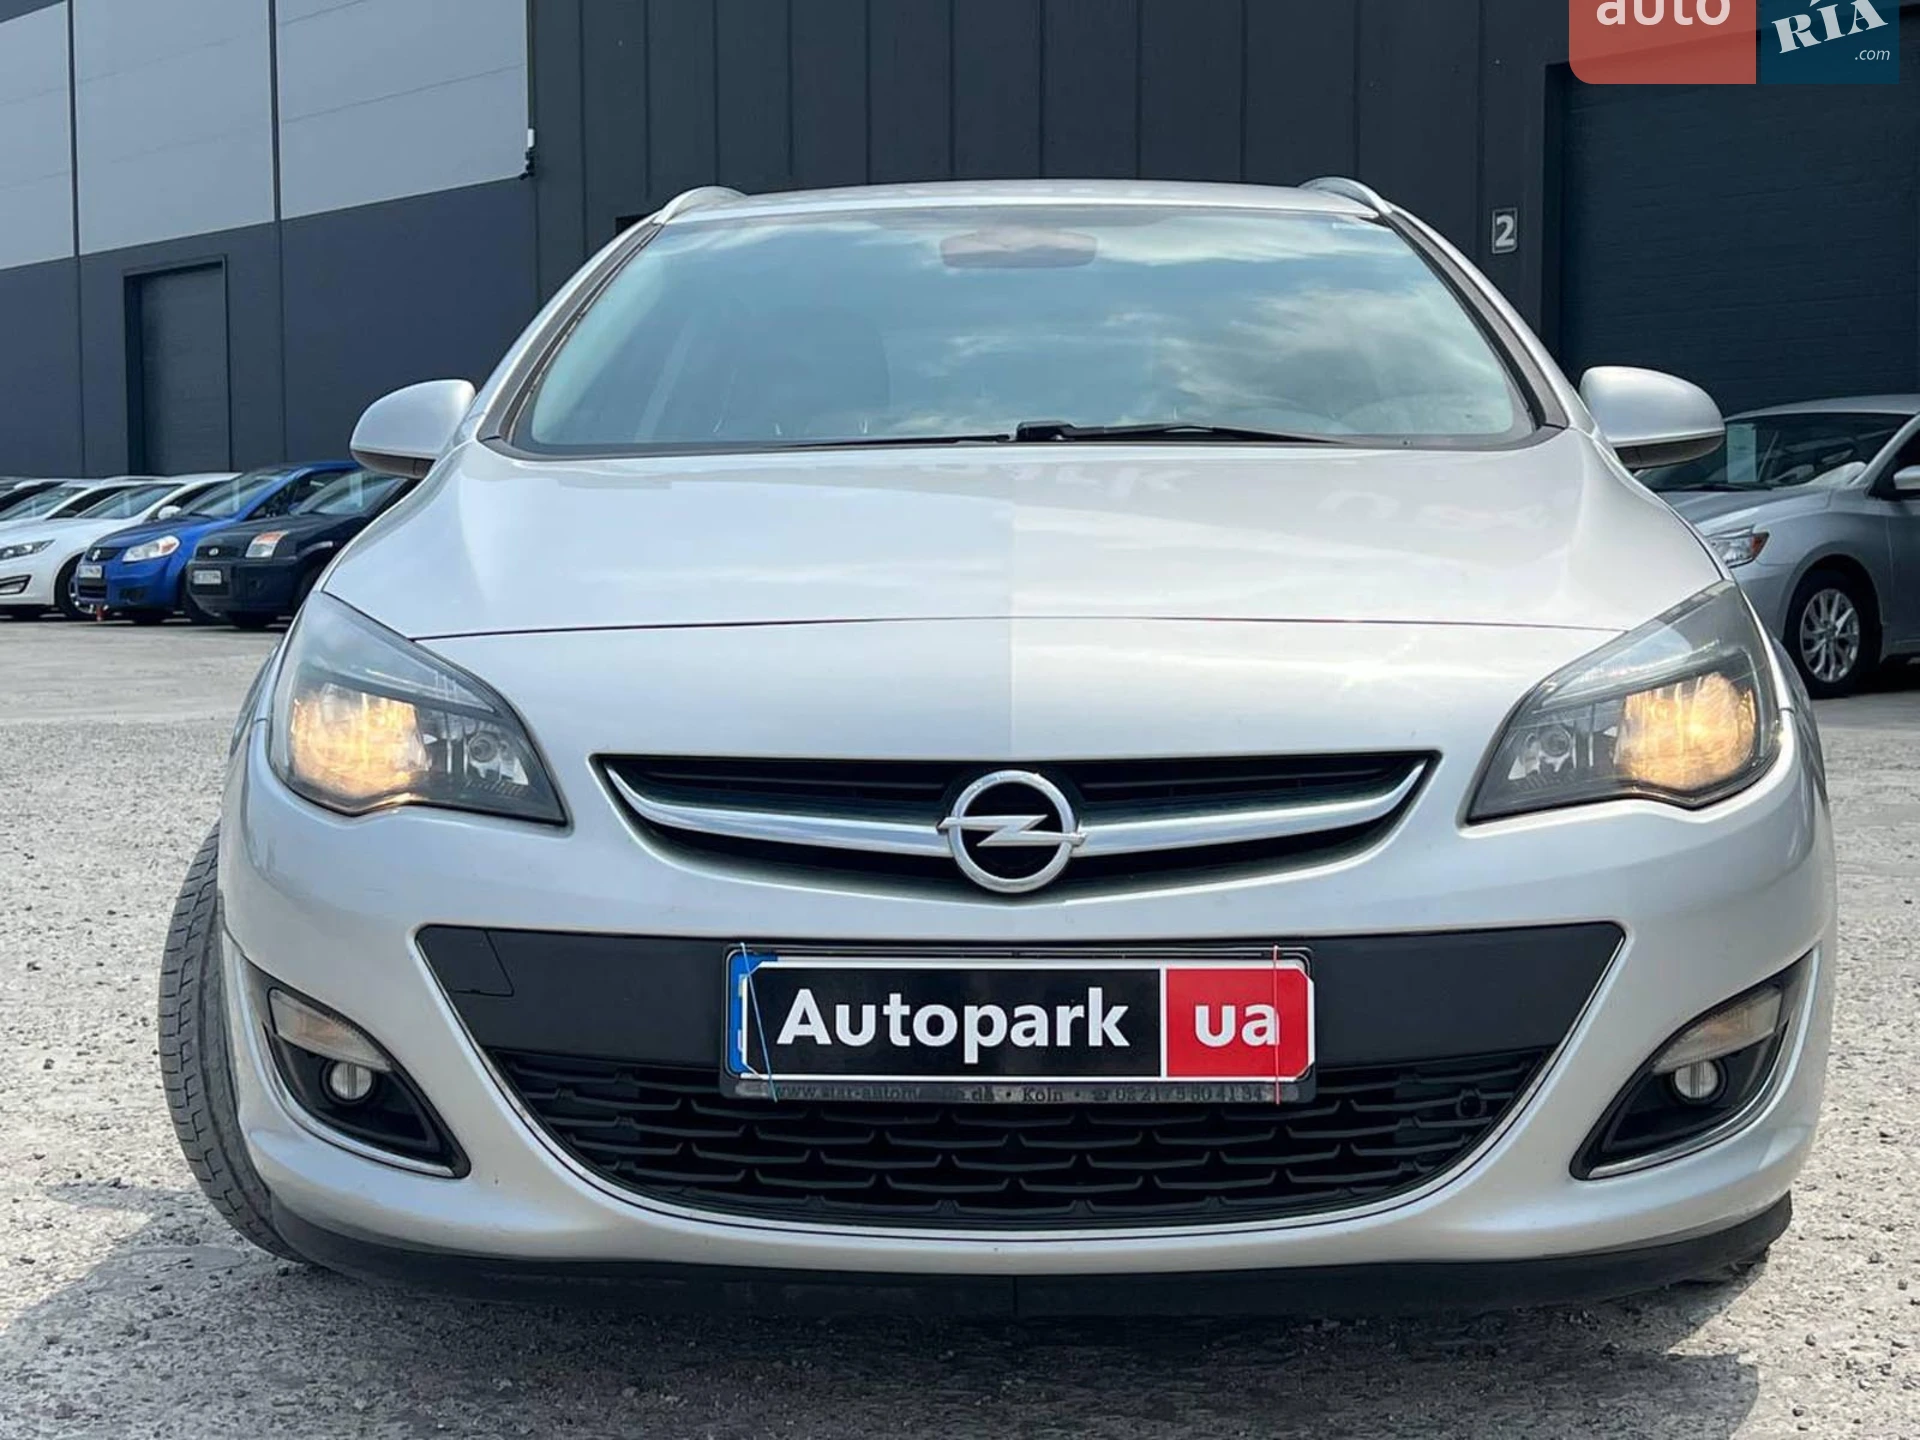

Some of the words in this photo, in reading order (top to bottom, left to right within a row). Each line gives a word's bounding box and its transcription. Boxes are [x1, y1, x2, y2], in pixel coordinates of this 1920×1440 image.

[1495, 214, 1515, 247] 2
[777, 988, 1130, 1064] Autopark
[1195, 1004, 1280, 1047] ua
